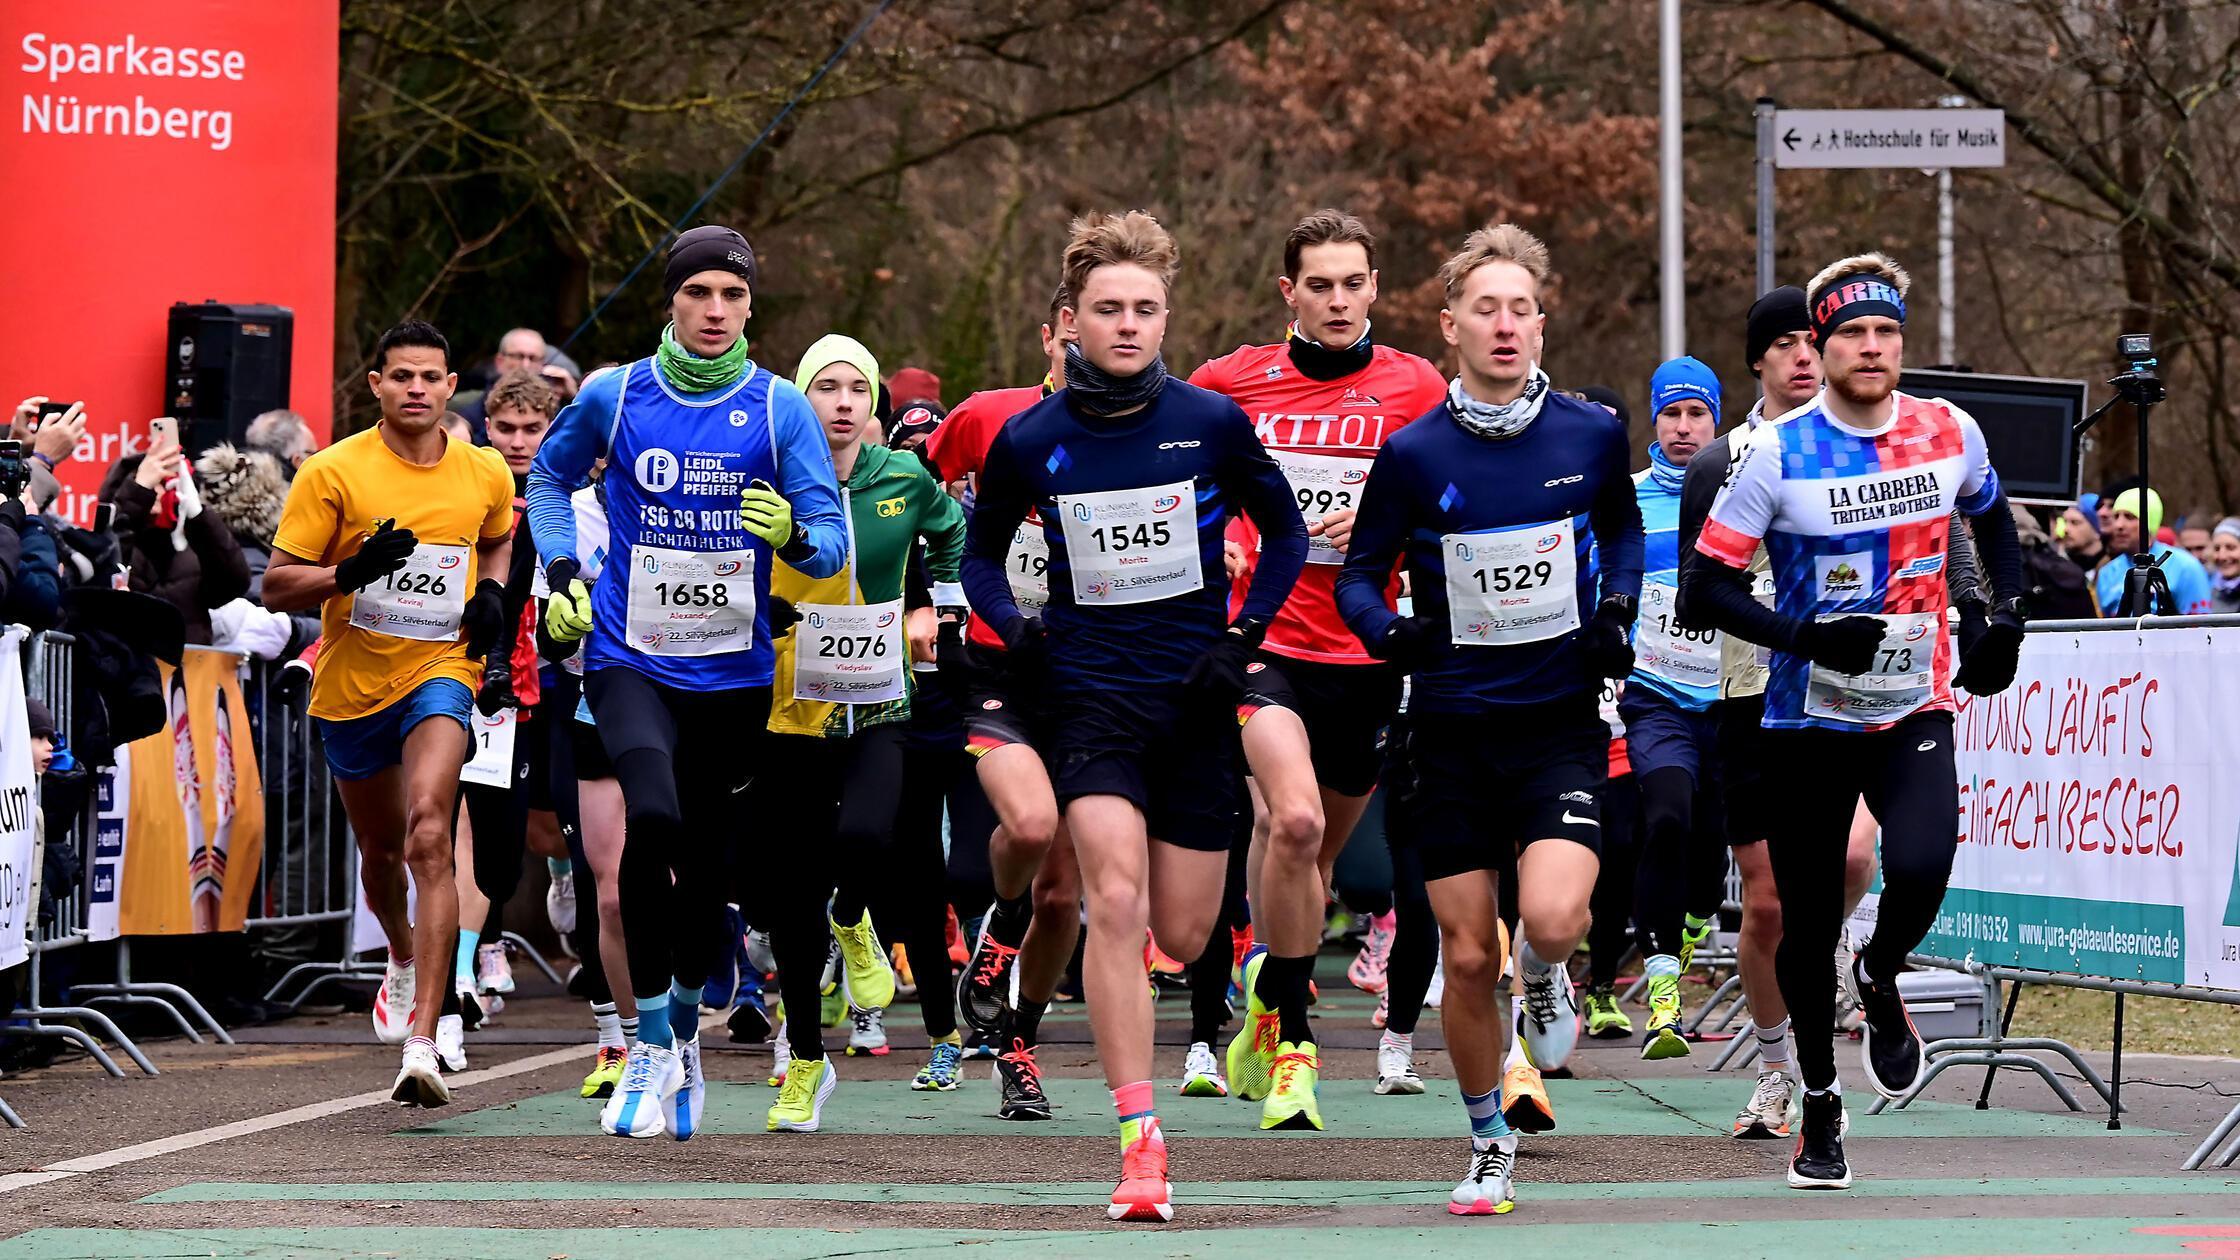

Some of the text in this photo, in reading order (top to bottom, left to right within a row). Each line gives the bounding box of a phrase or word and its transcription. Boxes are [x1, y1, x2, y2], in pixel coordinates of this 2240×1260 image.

[21, 33, 245, 82] Sparkasse
[23, 95, 233, 150] Nürnberg
[1844, 128, 1998, 148] Hochschule für Musik
[1255, 413, 1384, 447] KTT01
[685, 450, 741, 458] Versicherungsbüro
[684, 458, 725, 470] LEIDL
[684, 471, 746, 483] INDERST
[683, 484, 738, 496] PFEIFER
[1829, 472, 1940, 508] LA CARRERA
[1095, 496, 1174, 513] KLINIKUM tkn
[1831, 494, 1941, 525] TRITEAM ROTHSEE
[640, 504, 743, 531] TSG 08 ROTH
[639, 530, 743, 550] LEICHTATHLETIK
[1091, 520, 1171, 553] 1545
[662, 561, 704, 571] KLINIKUM
[1119, 556, 1149, 565] Moritz
[385, 571, 447, 597] 1626
[1131, 568, 1188, 587] Silvesterlauf
[1473, 561, 1553, 594] 1529
[398, 596, 424, 608] Kaviraj
[654, 582, 729, 607] 1658
[1500, 596, 1530, 606] Moritz
[403, 615, 450, 628] Silvesterlauf
[669, 612, 713, 620] Alexander
[1512, 608, 1567, 627] Silvesterlauf
[685, 627, 738, 640] Silvesterlauf
[819, 634, 887, 658] 2076
[1670, 642, 1693, 653] Tobias
[1673, 660, 1718, 674] Silvesterlauf
[1985, 681, 2041, 755] UNS
[2018, 920, 2179, 959] www.jura-gebaeudeservice.de
